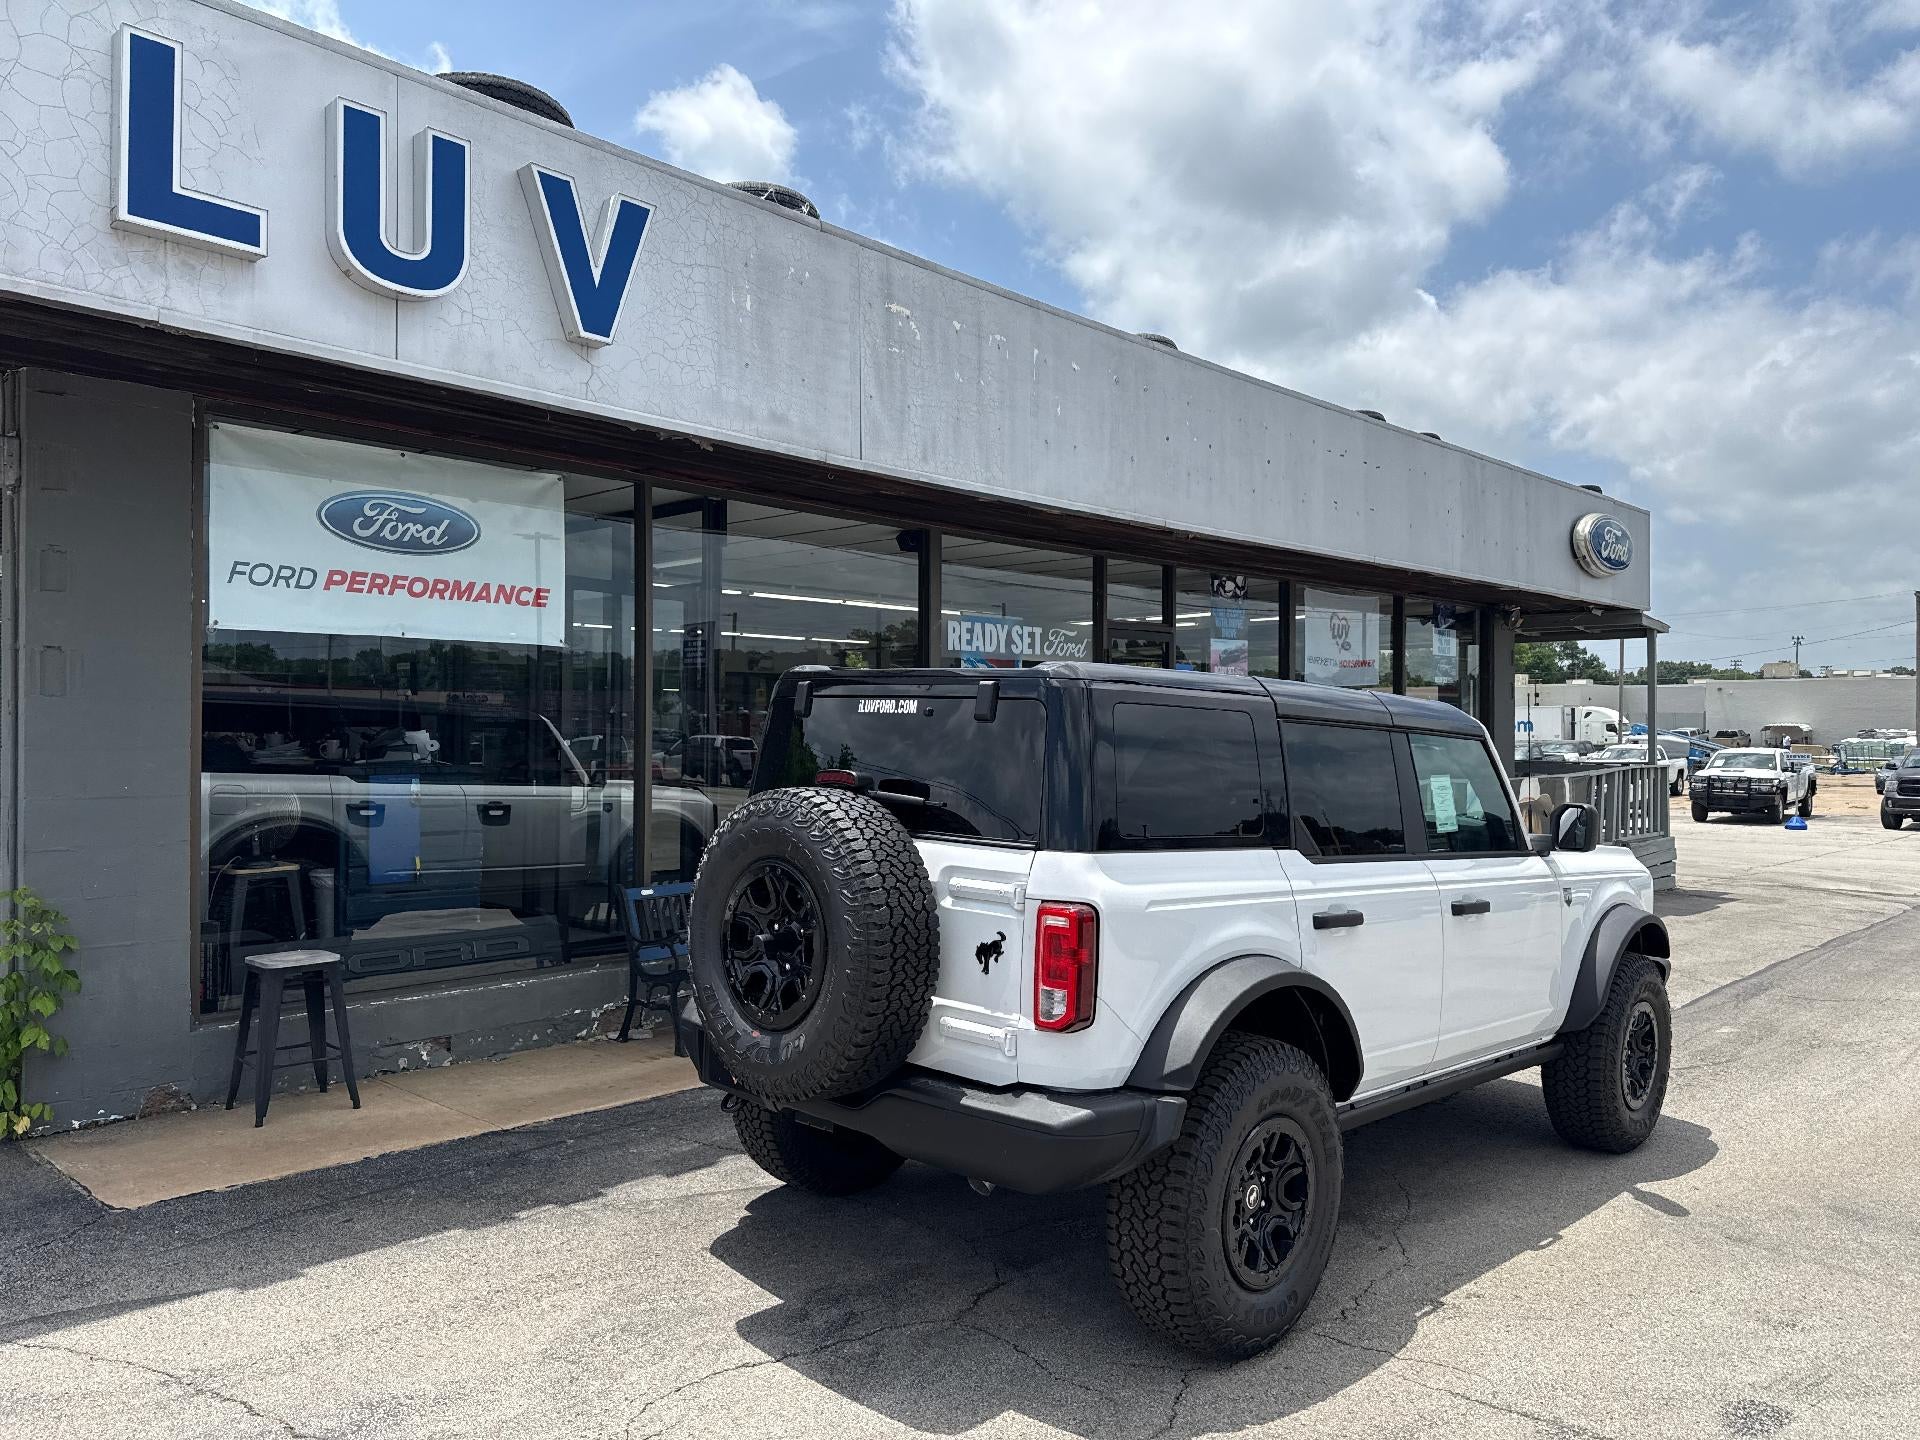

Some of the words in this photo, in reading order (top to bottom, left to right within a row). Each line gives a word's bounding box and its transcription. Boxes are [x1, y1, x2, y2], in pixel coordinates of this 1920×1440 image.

[111, 22, 657, 348] LUV
[352, 499, 451, 546] Ford
[1601, 526, 1629, 562] Ford
[226, 560, 318, 590] FORD
[323, 569, 551, 608] PERFORMANCE
[947, 620, 1008, 653] READY
[1011, 625, 1043, 655] SET
[1043, 628, 1088, 658] Ford
[1514, 720, 1534, 732] m
